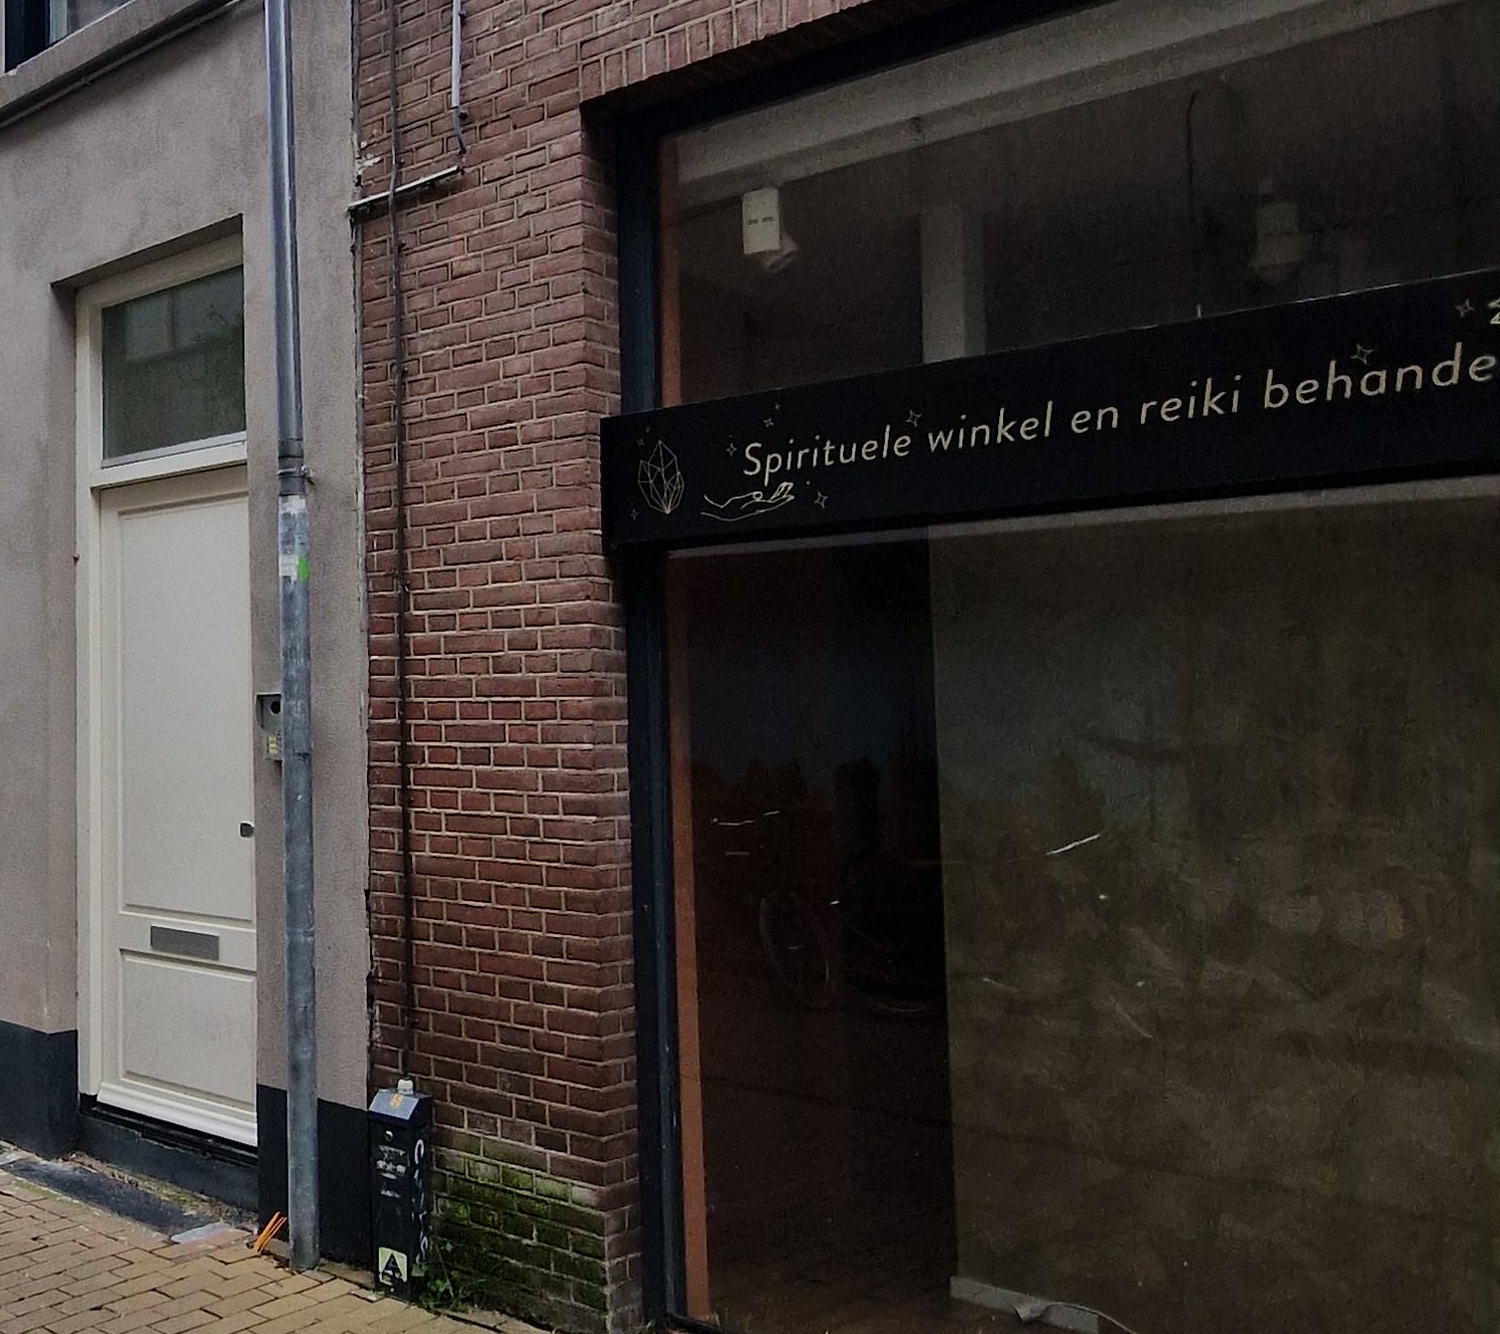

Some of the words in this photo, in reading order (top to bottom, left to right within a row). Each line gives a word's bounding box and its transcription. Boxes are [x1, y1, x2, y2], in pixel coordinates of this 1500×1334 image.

[743, 425, 911, 486] Spirituele
[927, 400, 1054, 452] winkel
[1071, 405, 1119, 434] en
[1140, 375, 1242, 425] reiki
[1264, 342, 1498, 410] behande
